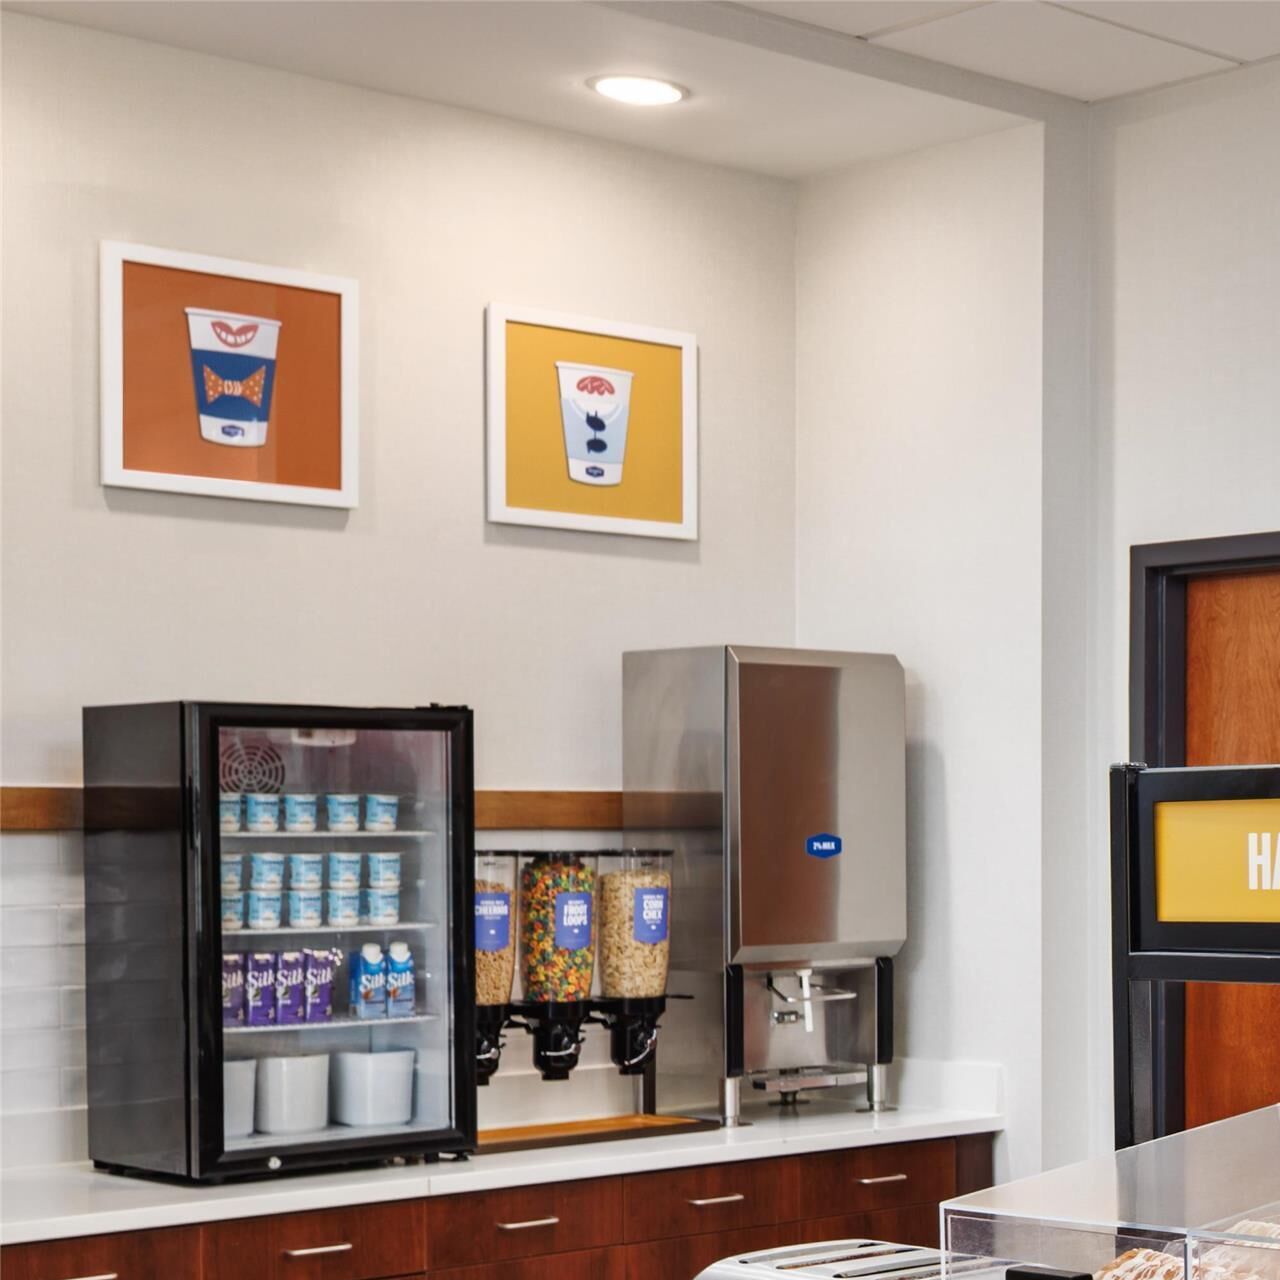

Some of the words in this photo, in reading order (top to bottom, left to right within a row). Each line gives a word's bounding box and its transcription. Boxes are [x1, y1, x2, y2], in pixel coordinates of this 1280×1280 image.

[563, 914, 588, 926] LOOPS
[247, 968, 275, 989] Silk
[276, 968, 304, 988] Silk
[307, 967, 333, 986] Silk
[360, 971, 386, 989] Silk
[388, 970, 415, 988] Silk
